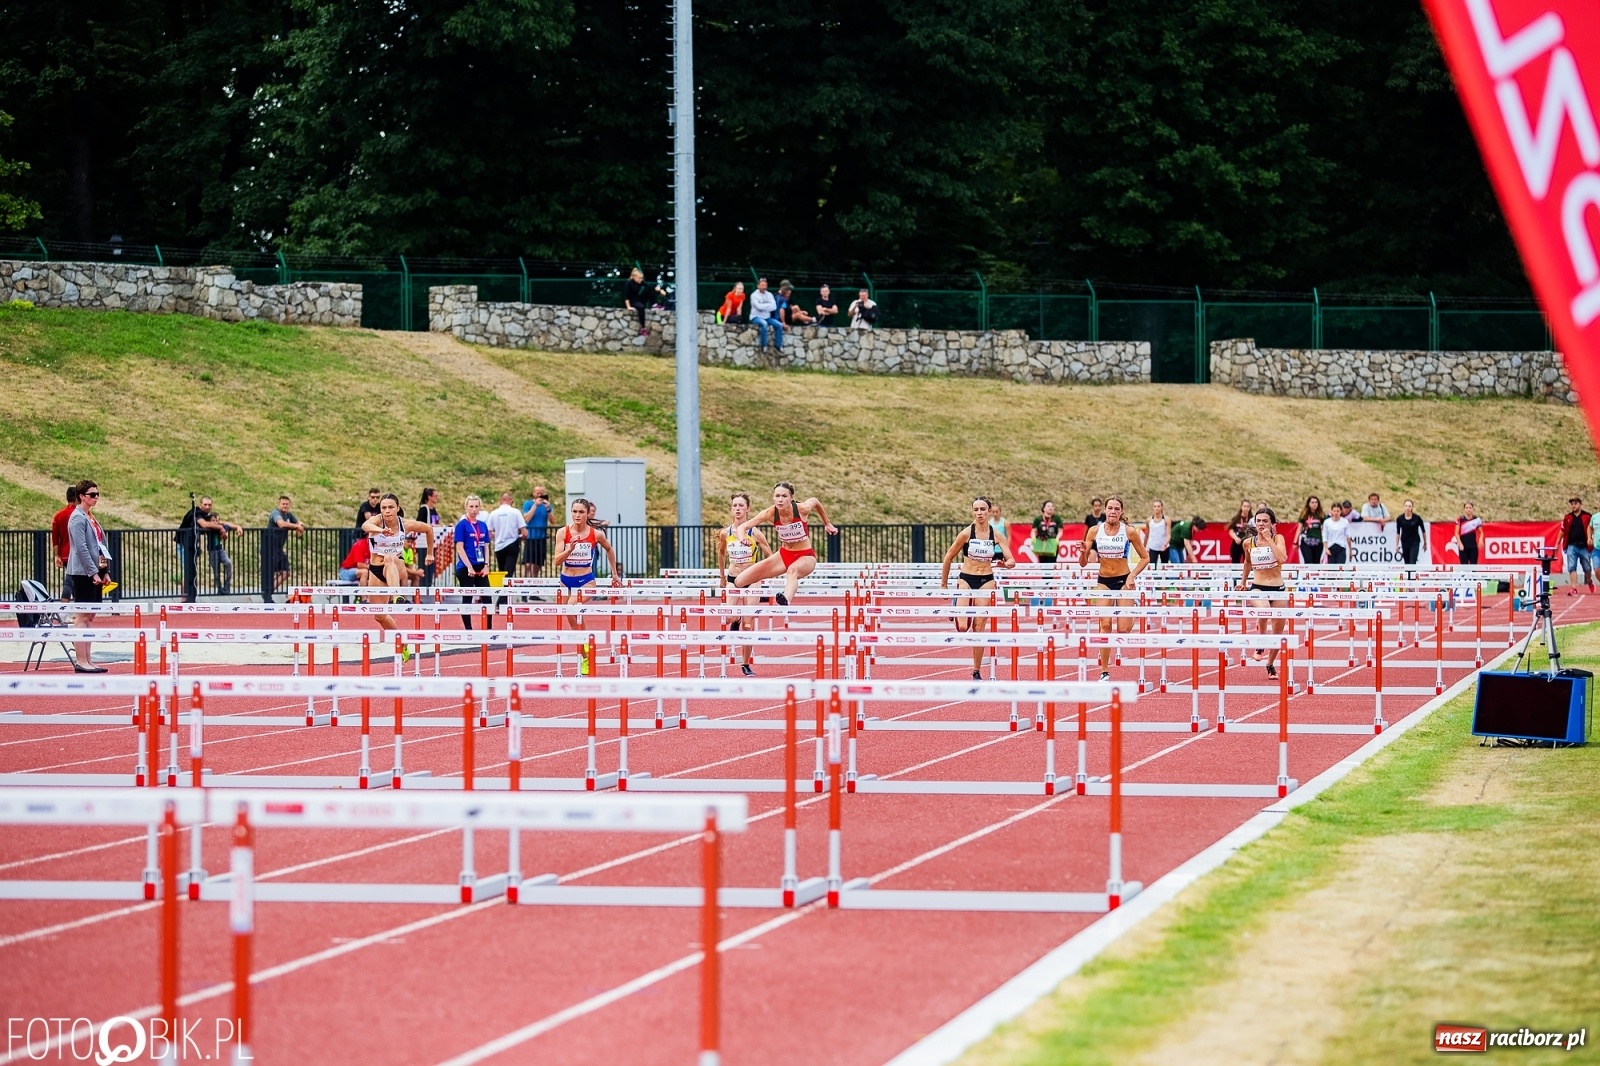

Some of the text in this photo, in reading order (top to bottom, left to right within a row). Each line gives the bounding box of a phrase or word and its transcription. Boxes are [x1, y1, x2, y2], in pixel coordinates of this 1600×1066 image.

[1350, 536, 1386, 544] MIASTO
[1191, 540, 1230, 560] PZL
[1350, 546, 1402, 562] Racibó
[1489, 541, 1540, 554] ORLEN
